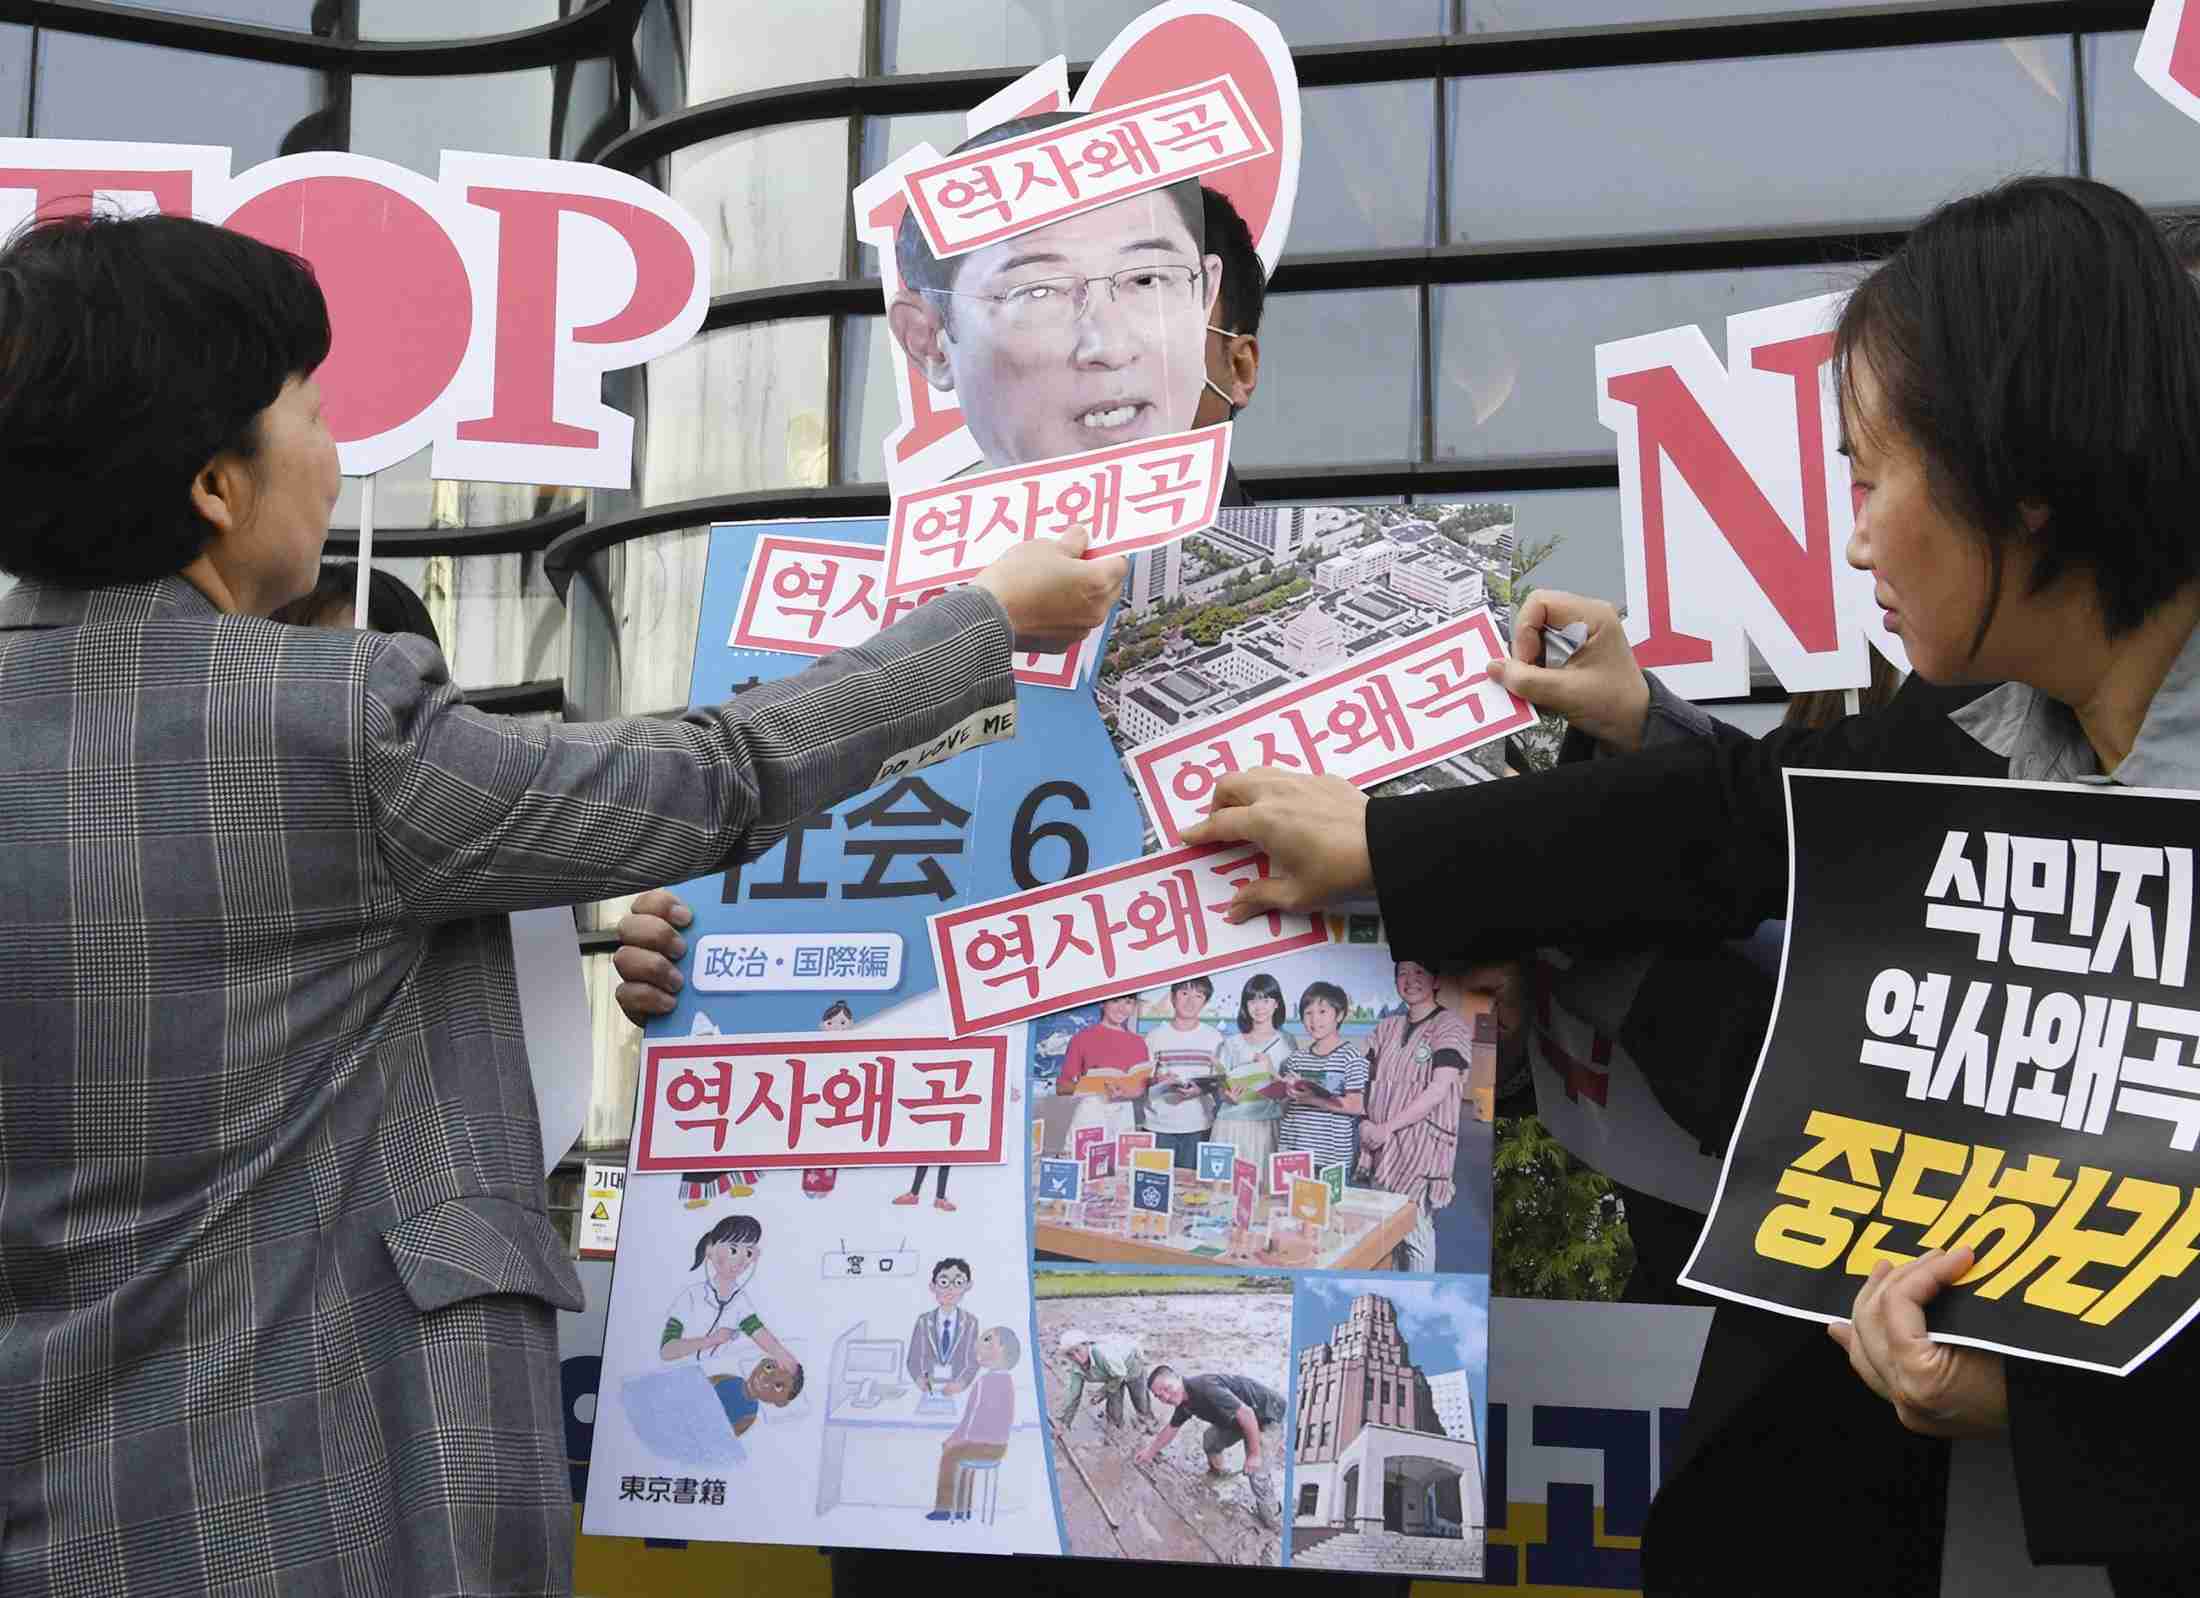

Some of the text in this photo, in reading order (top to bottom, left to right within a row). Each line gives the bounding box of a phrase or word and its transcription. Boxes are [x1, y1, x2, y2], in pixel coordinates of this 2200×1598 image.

[937, 103, 1229, 225] 역사왜곡
[0, 168, 696, 450] OP
[912, 453, 1203, 569] 역사왜곡
[918, 726, 971, 763] LOVE
[983, 712, 1013, 735] ME
[1172, 646, 1492, 815] 역사왜곡
[1010, 780, 1092, 891] 6
[965, 850, 1282, 1000] 역사왜곡
[1924, 829, 2194, 988] 식민지
[665, 1055, 983, 1153] 역사왜곡
[1859, 967, 2200, 1153] 역사왜곡
[1755, 1109, 2200, 1327] 중단하라
[618, 1474, 728, 1507] 東京書籍
